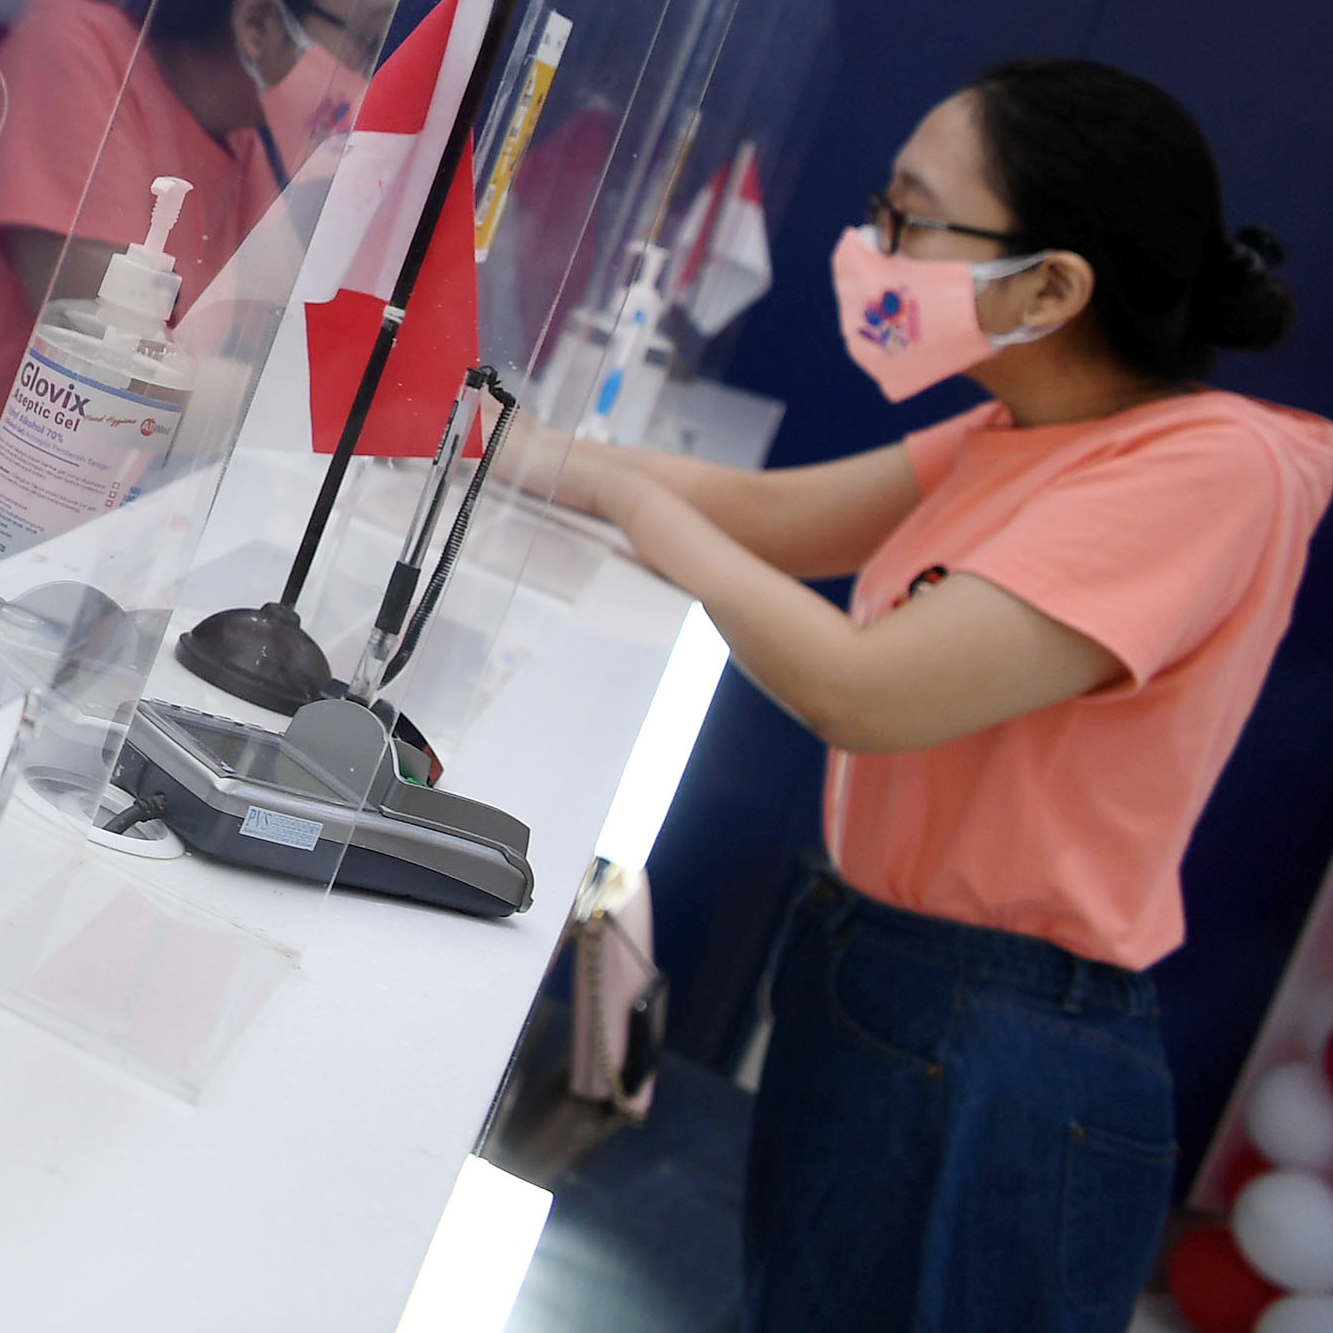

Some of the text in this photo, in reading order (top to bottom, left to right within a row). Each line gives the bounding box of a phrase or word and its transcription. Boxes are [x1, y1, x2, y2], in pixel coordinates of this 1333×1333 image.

[13, 388, 51, 419] Aseptic
[54, 411, 81, 432] Gel
[21, 362, 91, 417] Glovix
